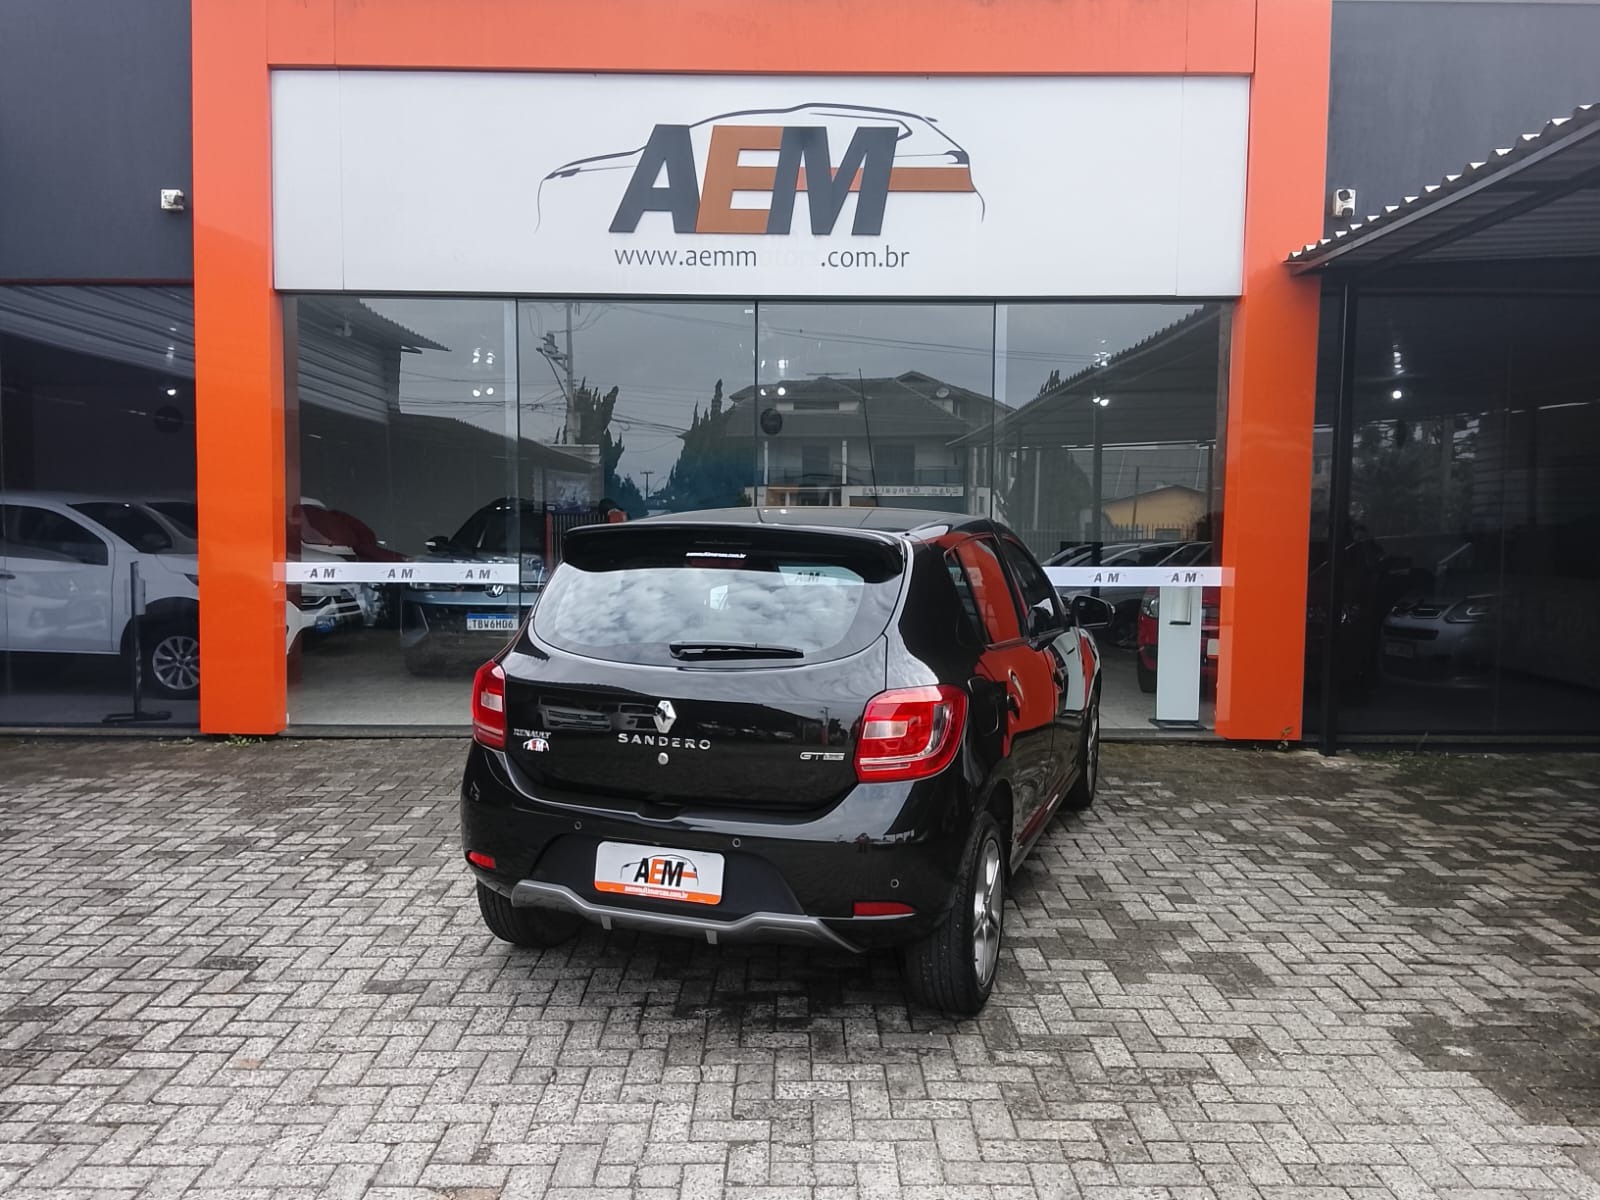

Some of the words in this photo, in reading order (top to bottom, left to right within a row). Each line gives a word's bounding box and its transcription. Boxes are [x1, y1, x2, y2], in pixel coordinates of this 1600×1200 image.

[609, 124, 899, 236] AEM
[513, 728, 552, 739] RENAULT
[617, 732, 711, 750] SANDERO
[633, 857, 685, 887] AEM
